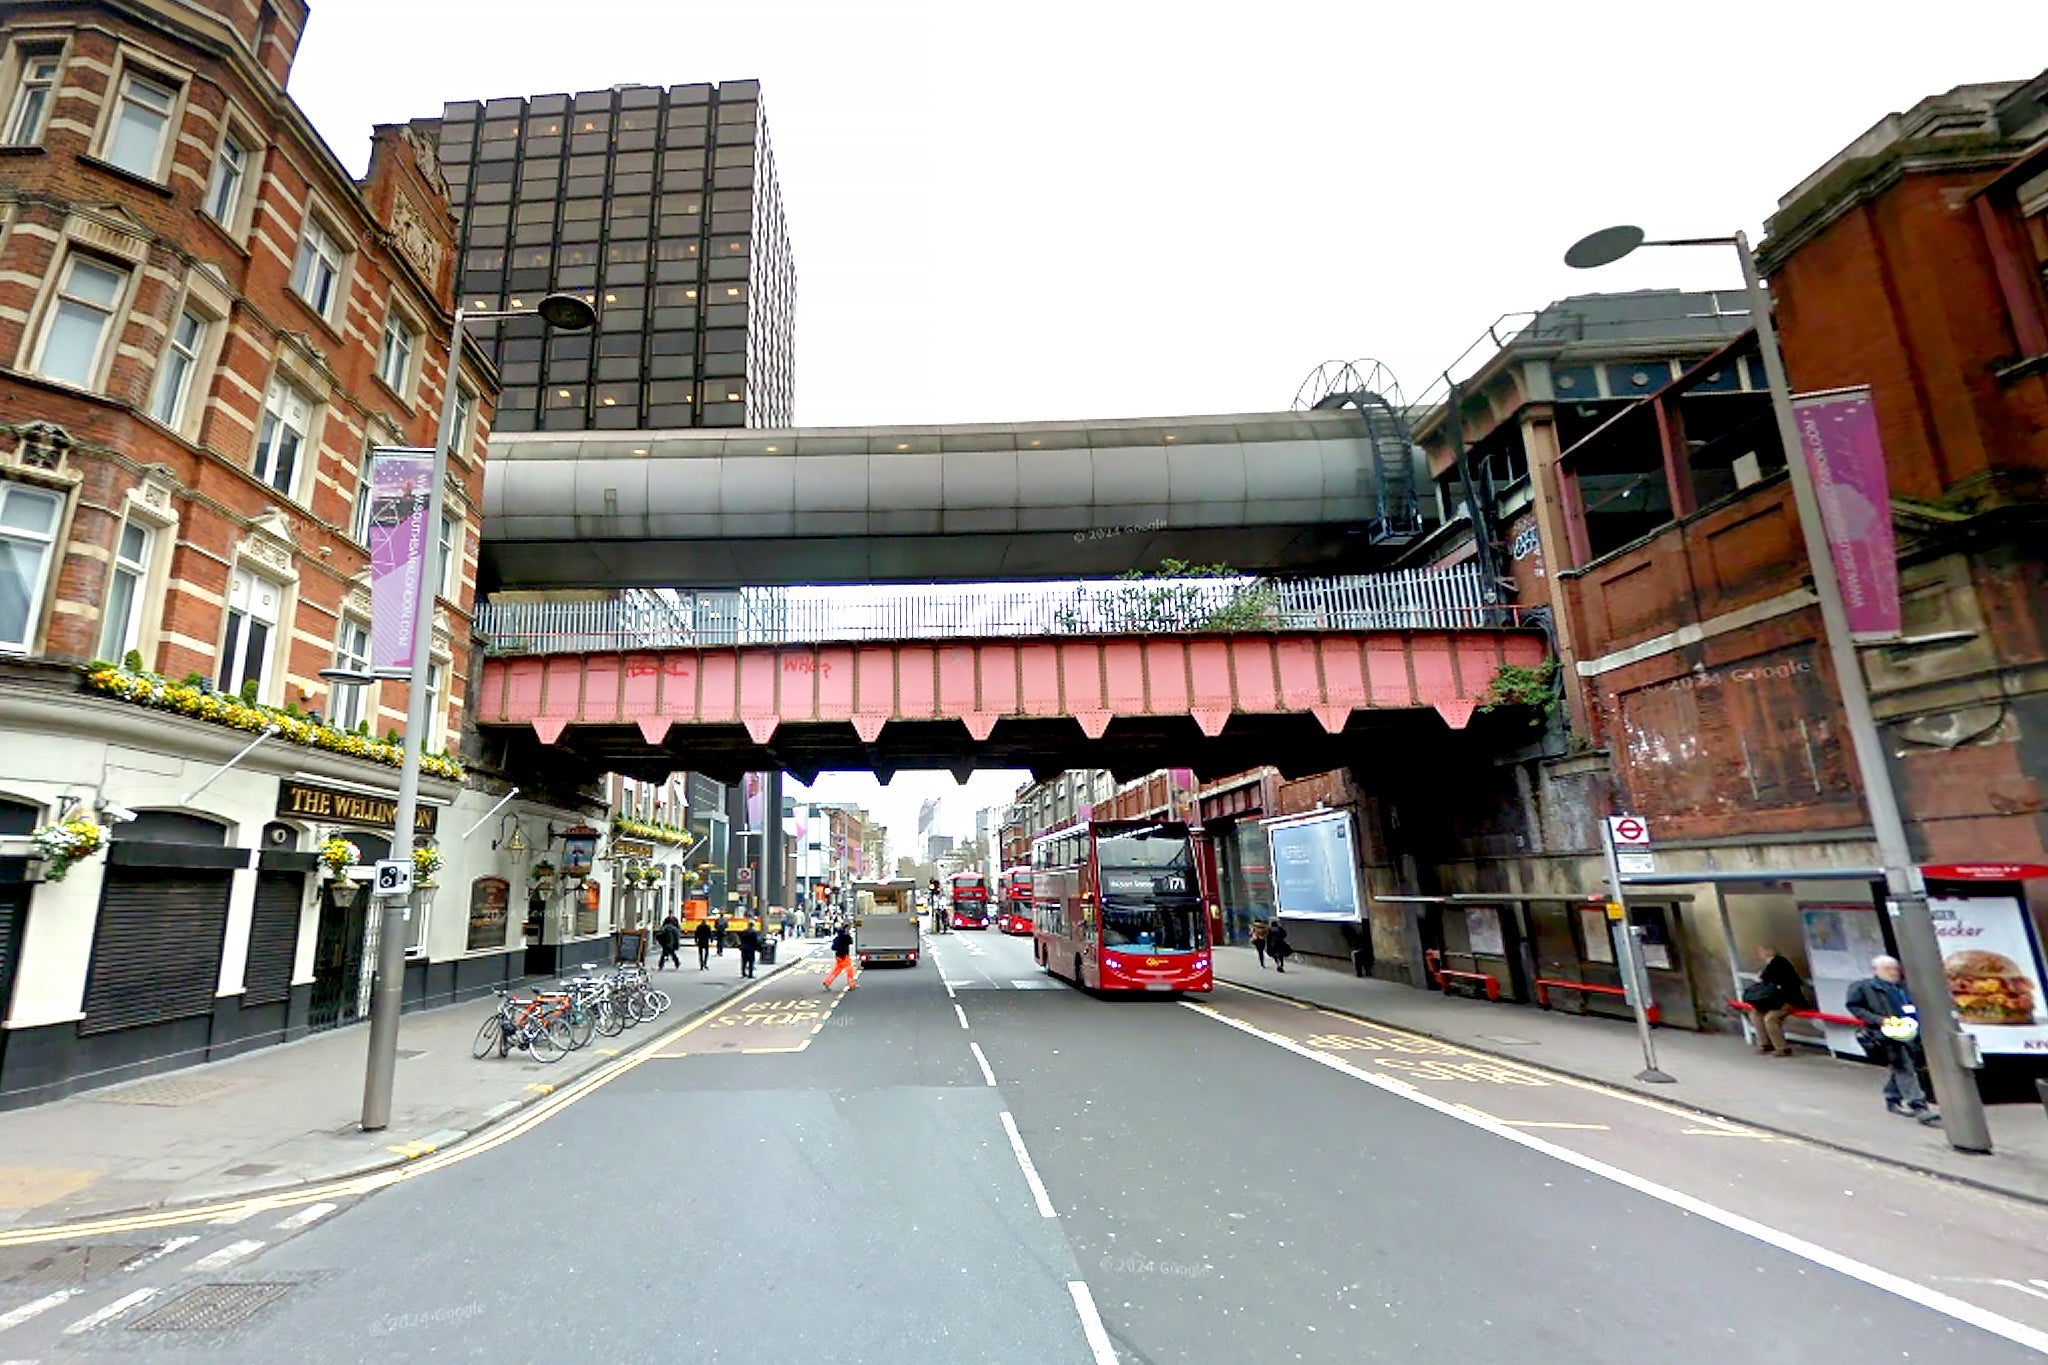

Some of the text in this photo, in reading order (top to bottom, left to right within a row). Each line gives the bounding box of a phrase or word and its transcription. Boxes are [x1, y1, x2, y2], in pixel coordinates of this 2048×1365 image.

[292, 787, 433, 829] THE WELLINN
[742, 999, 821, 1012] BUS
[710, 1012, 819, 1027] STOP
